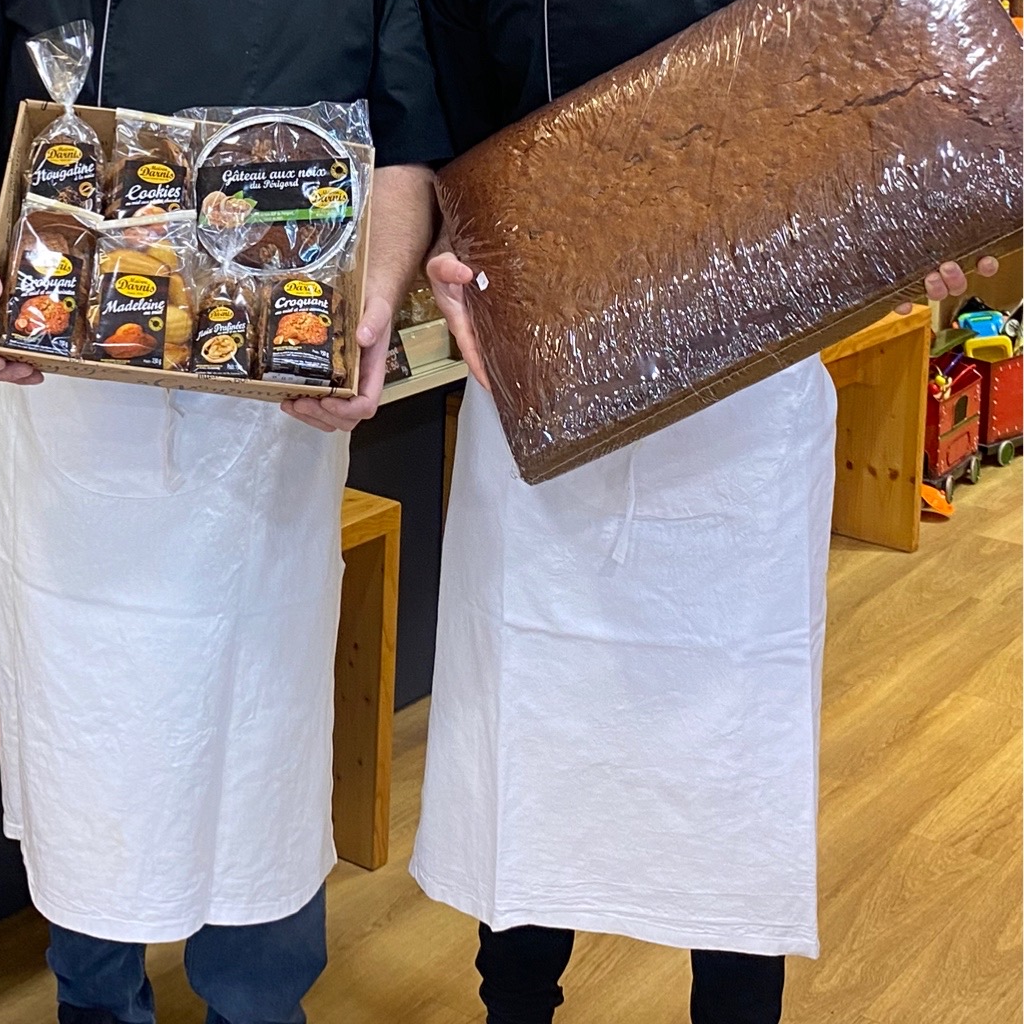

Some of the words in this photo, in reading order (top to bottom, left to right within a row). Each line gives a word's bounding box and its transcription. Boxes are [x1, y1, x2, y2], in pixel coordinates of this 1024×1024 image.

[47, 149, 82, 160] Darnis
[32, 162, 96, 186] Nougatine
[140, 166, 174, 179] Darnis
[222, 169, 267, 186] Gâteau
[269, 169, 296, 180] aux
[298, 167, 327, 179] noix
[250, 180, 262, 190] du
[263, 178, 299, 191] Périgord
[125, 184, 182, 201] Cookies
[117, 278, 156, 293] Darnis
[102, 298, 165, 316] Madeleine
[274, 296, 329, 309] Craquant
